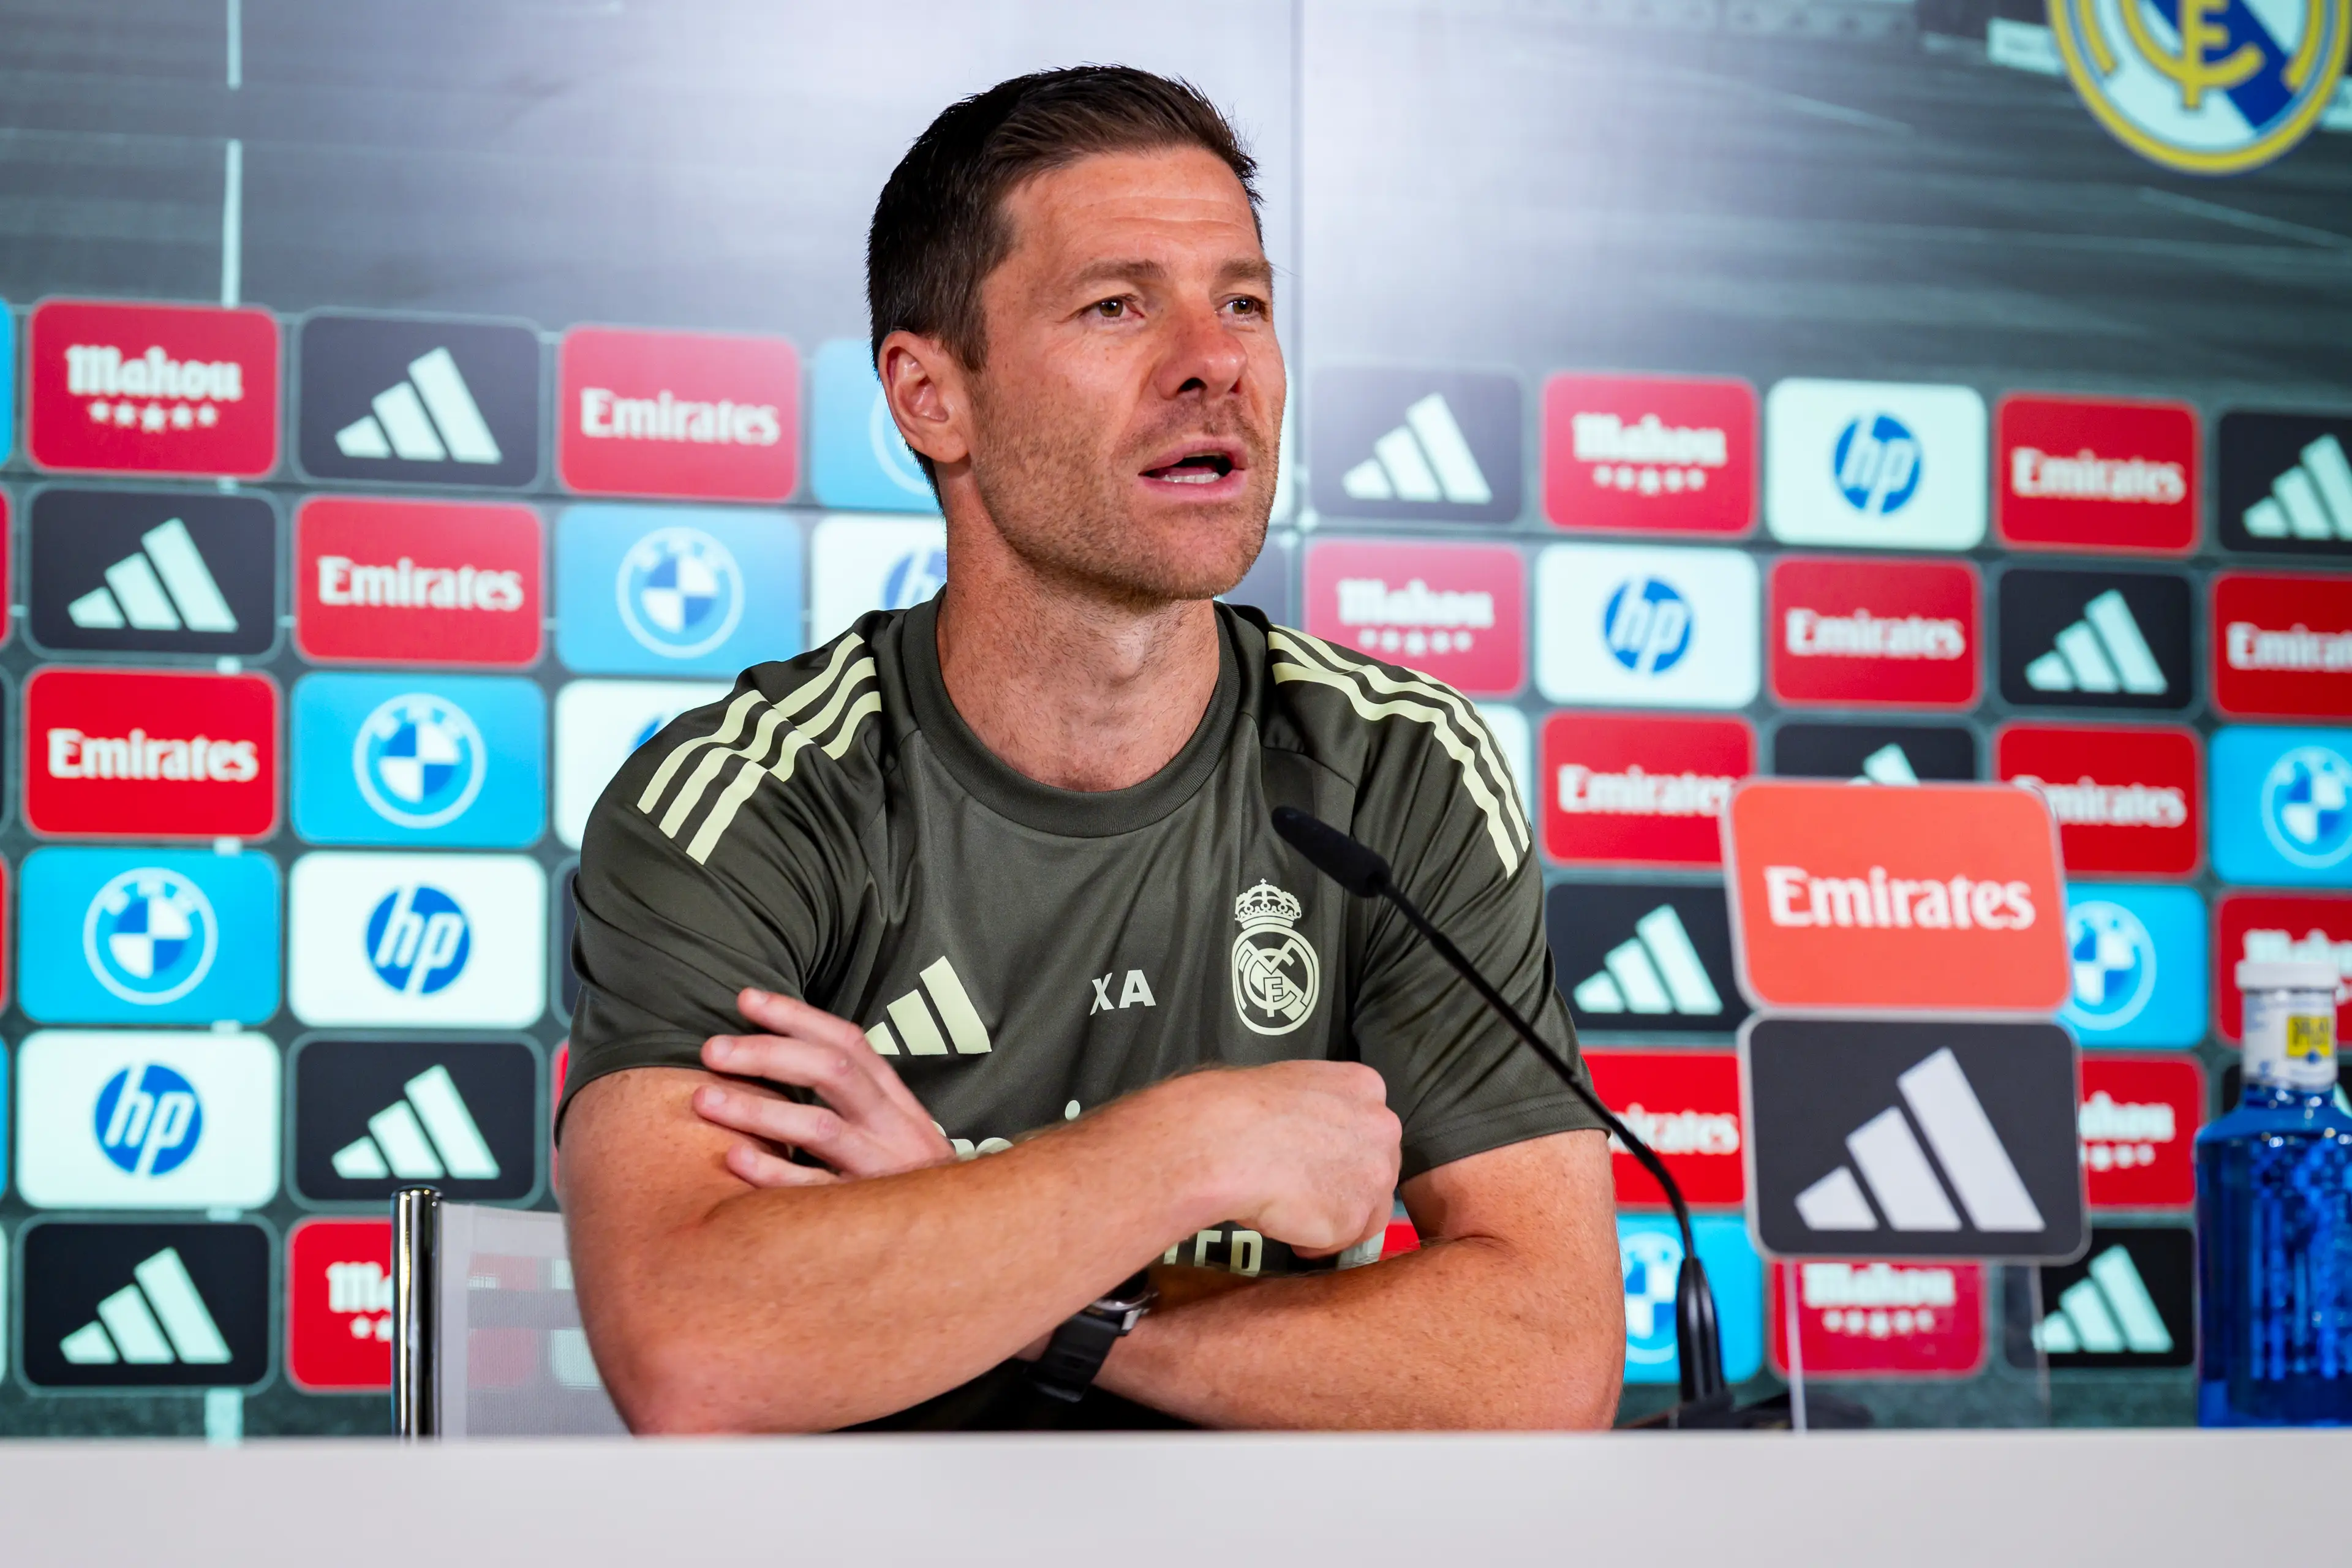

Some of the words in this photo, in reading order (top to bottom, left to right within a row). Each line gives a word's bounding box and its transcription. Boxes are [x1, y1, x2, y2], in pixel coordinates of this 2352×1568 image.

[65, 344, 244, 402] Mahou
[581, 387, 781, 446] Emirates
[1838, 413, 1918, 514] hp
[2011, 447, 2185, 503] Emirates
[317, 556, 524, 611] Emirates
[1606, 576, 1689, 674] hp
[1785, 608, 1965, 660] Emirates
[48, 728, 259, 782] Emirates
[2011, 775, 2187, 827] mirates
[1764, 865, 2035, 930] Emirates
[371, 884, 469, 995] hp
[1090, 969, 1156, 1016] XA
[100, 1062, 199, 1177] hp
